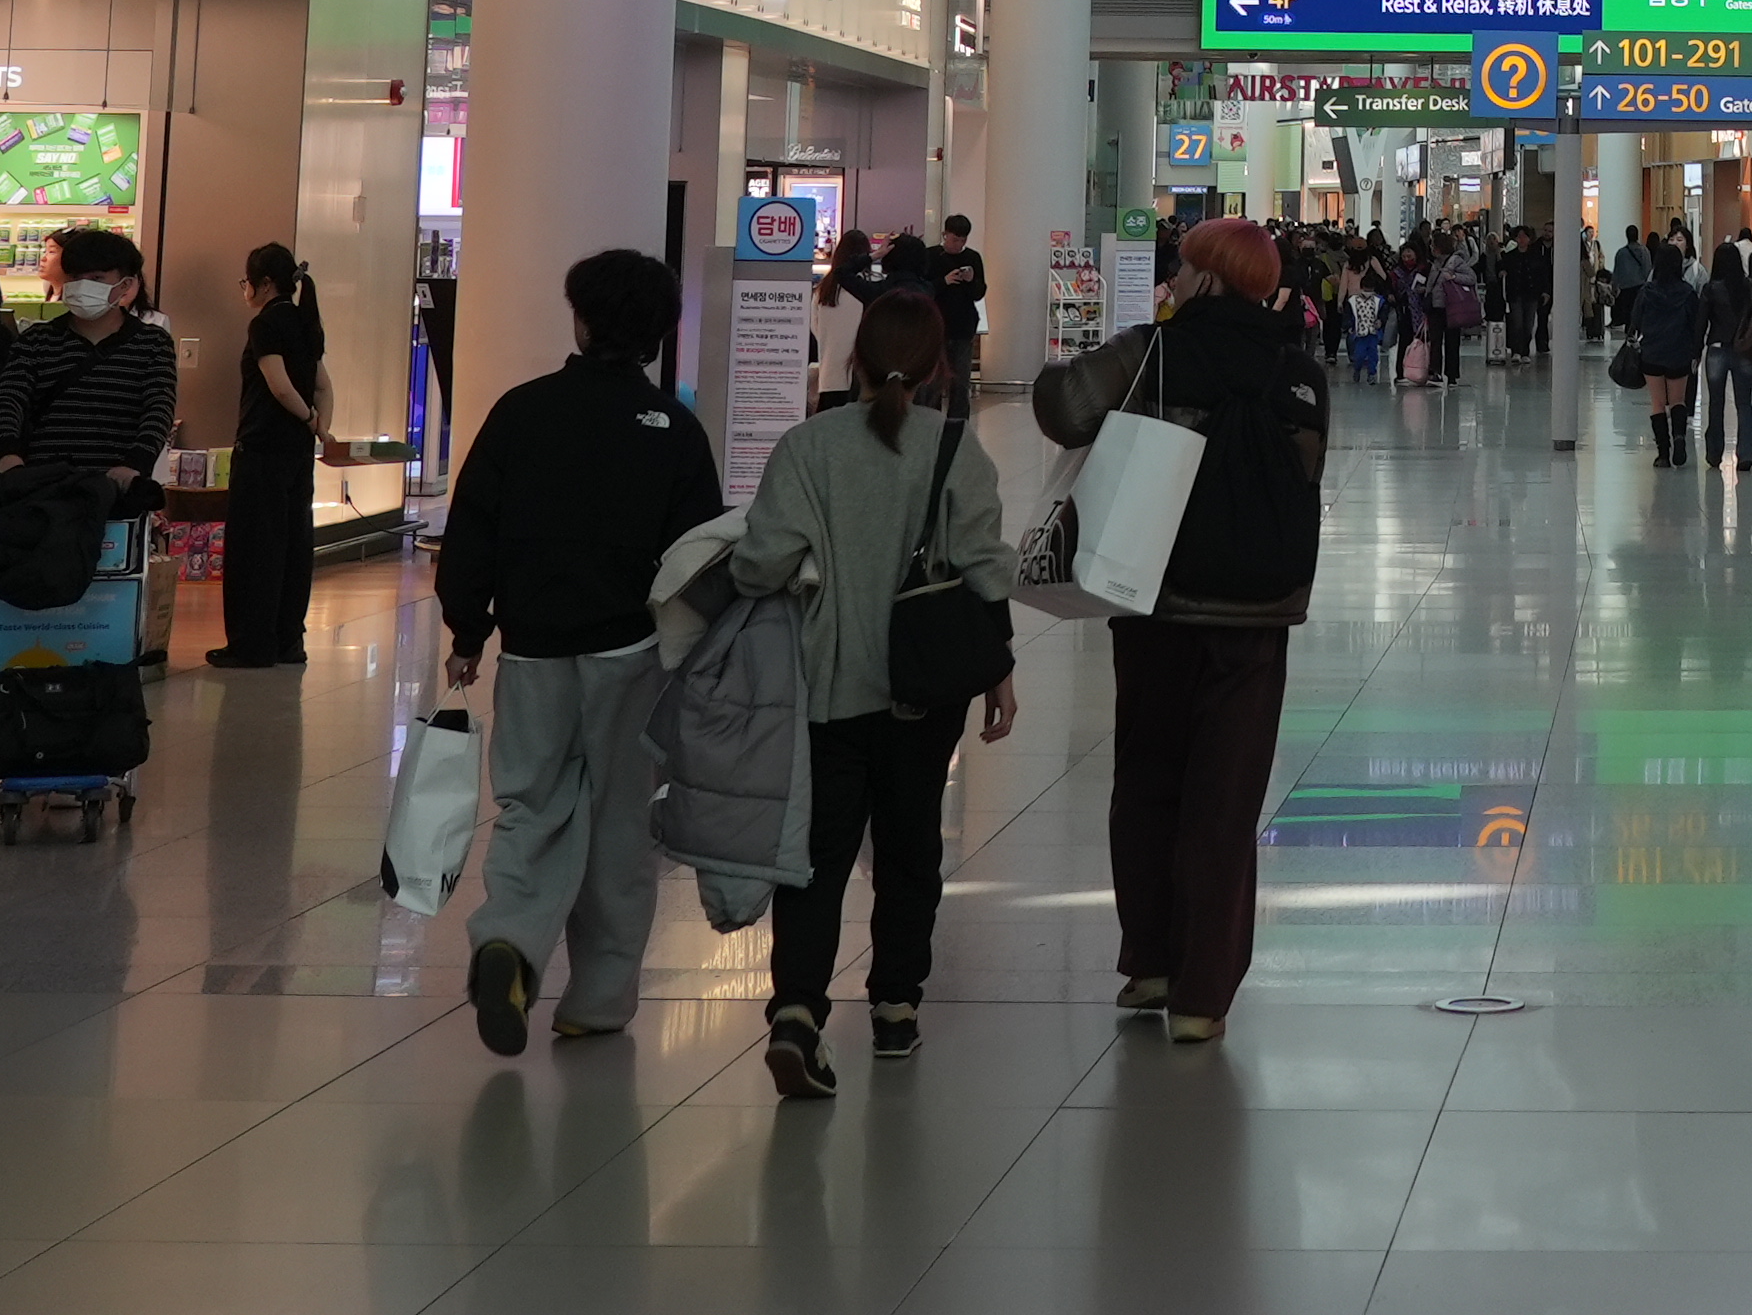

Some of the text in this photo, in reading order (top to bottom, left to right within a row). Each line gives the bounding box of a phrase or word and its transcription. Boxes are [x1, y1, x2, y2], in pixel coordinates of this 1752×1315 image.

[1263, 14, 1284, 25] 50m
[1618, 37, 1742, 69] 101-291
[1354, 93, 1469, 112] Transfer Desk
[1617, 82, 1710, 113] 26-50
[1174, 134, 1207, 159] 27
[36, 151, 78, 163] SAY NO
[756, 215, 797, 236] 담배
[1126, 216, 1147, 227] 소주
[0, 622, 111, 632] Taste World-class Cuisine
